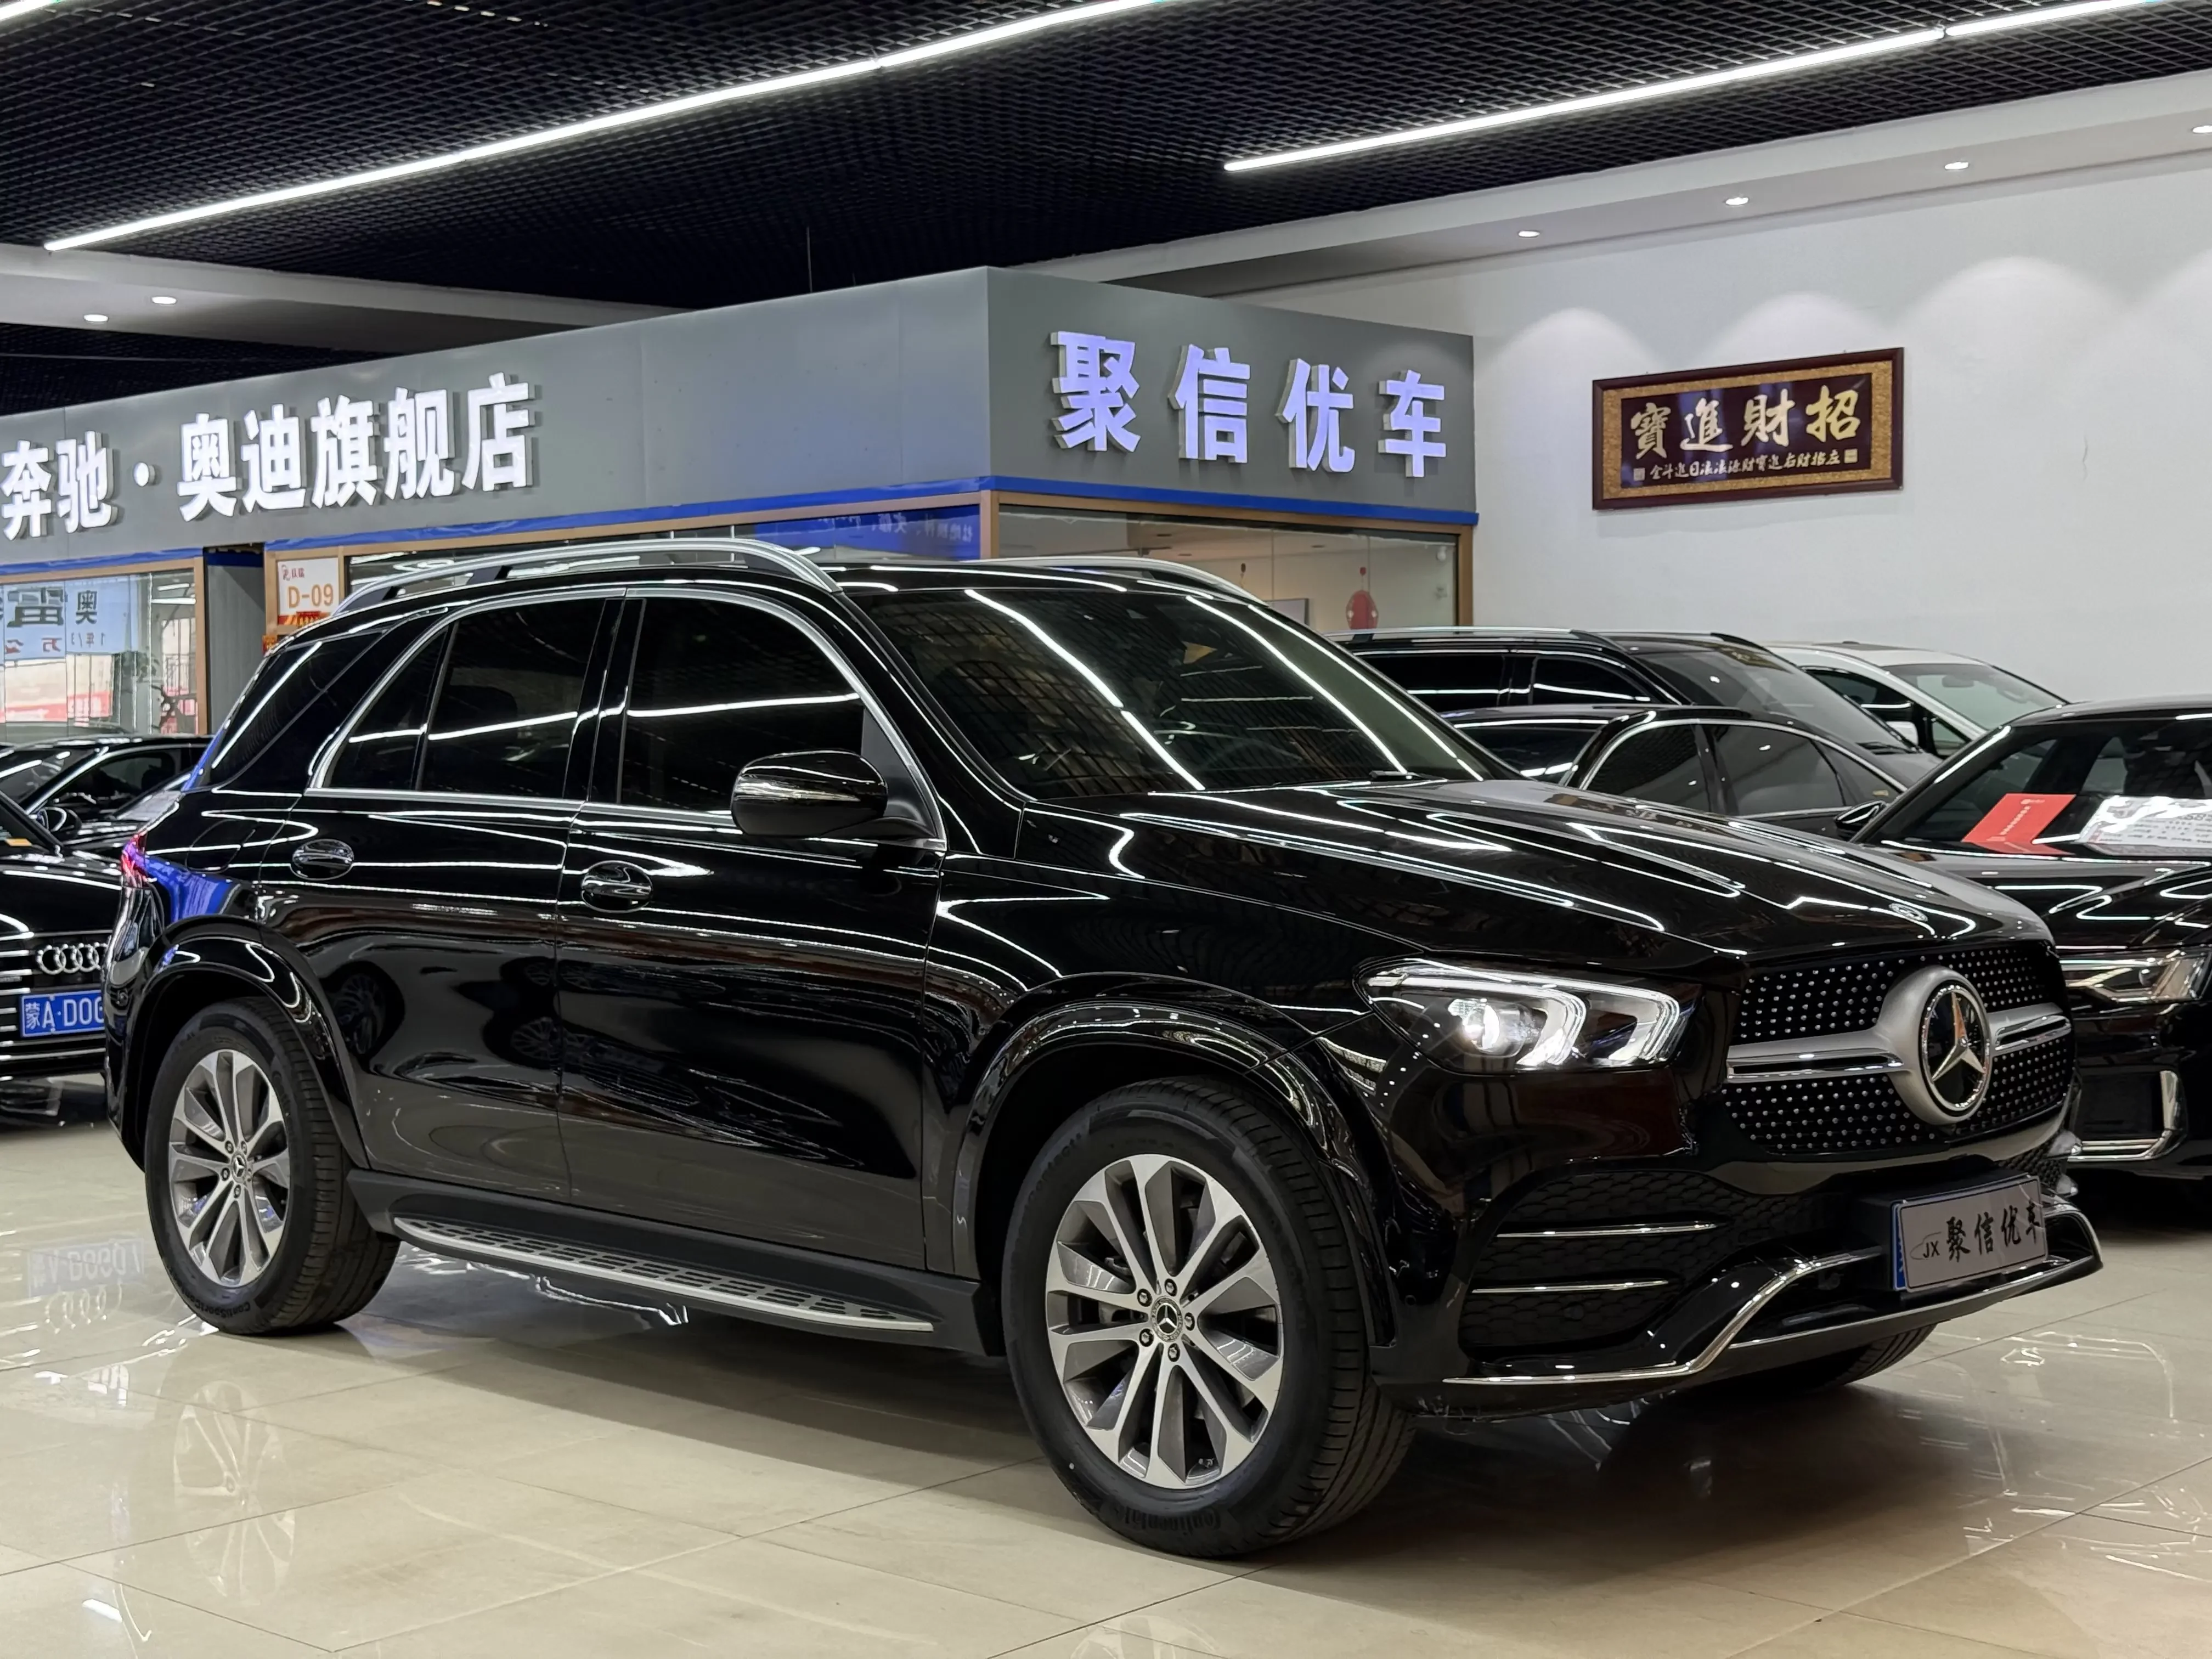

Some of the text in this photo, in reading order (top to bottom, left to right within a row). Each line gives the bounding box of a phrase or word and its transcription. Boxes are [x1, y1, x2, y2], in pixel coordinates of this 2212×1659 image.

[2, 372, 534, 540] 奔驰·奥迪旗舰店
[1051, 330, 1447, 478] 聚信优车
[287, 583, 334, 609] D-09
[1922, 1200, 2041, 1263] JX 聚信优车
